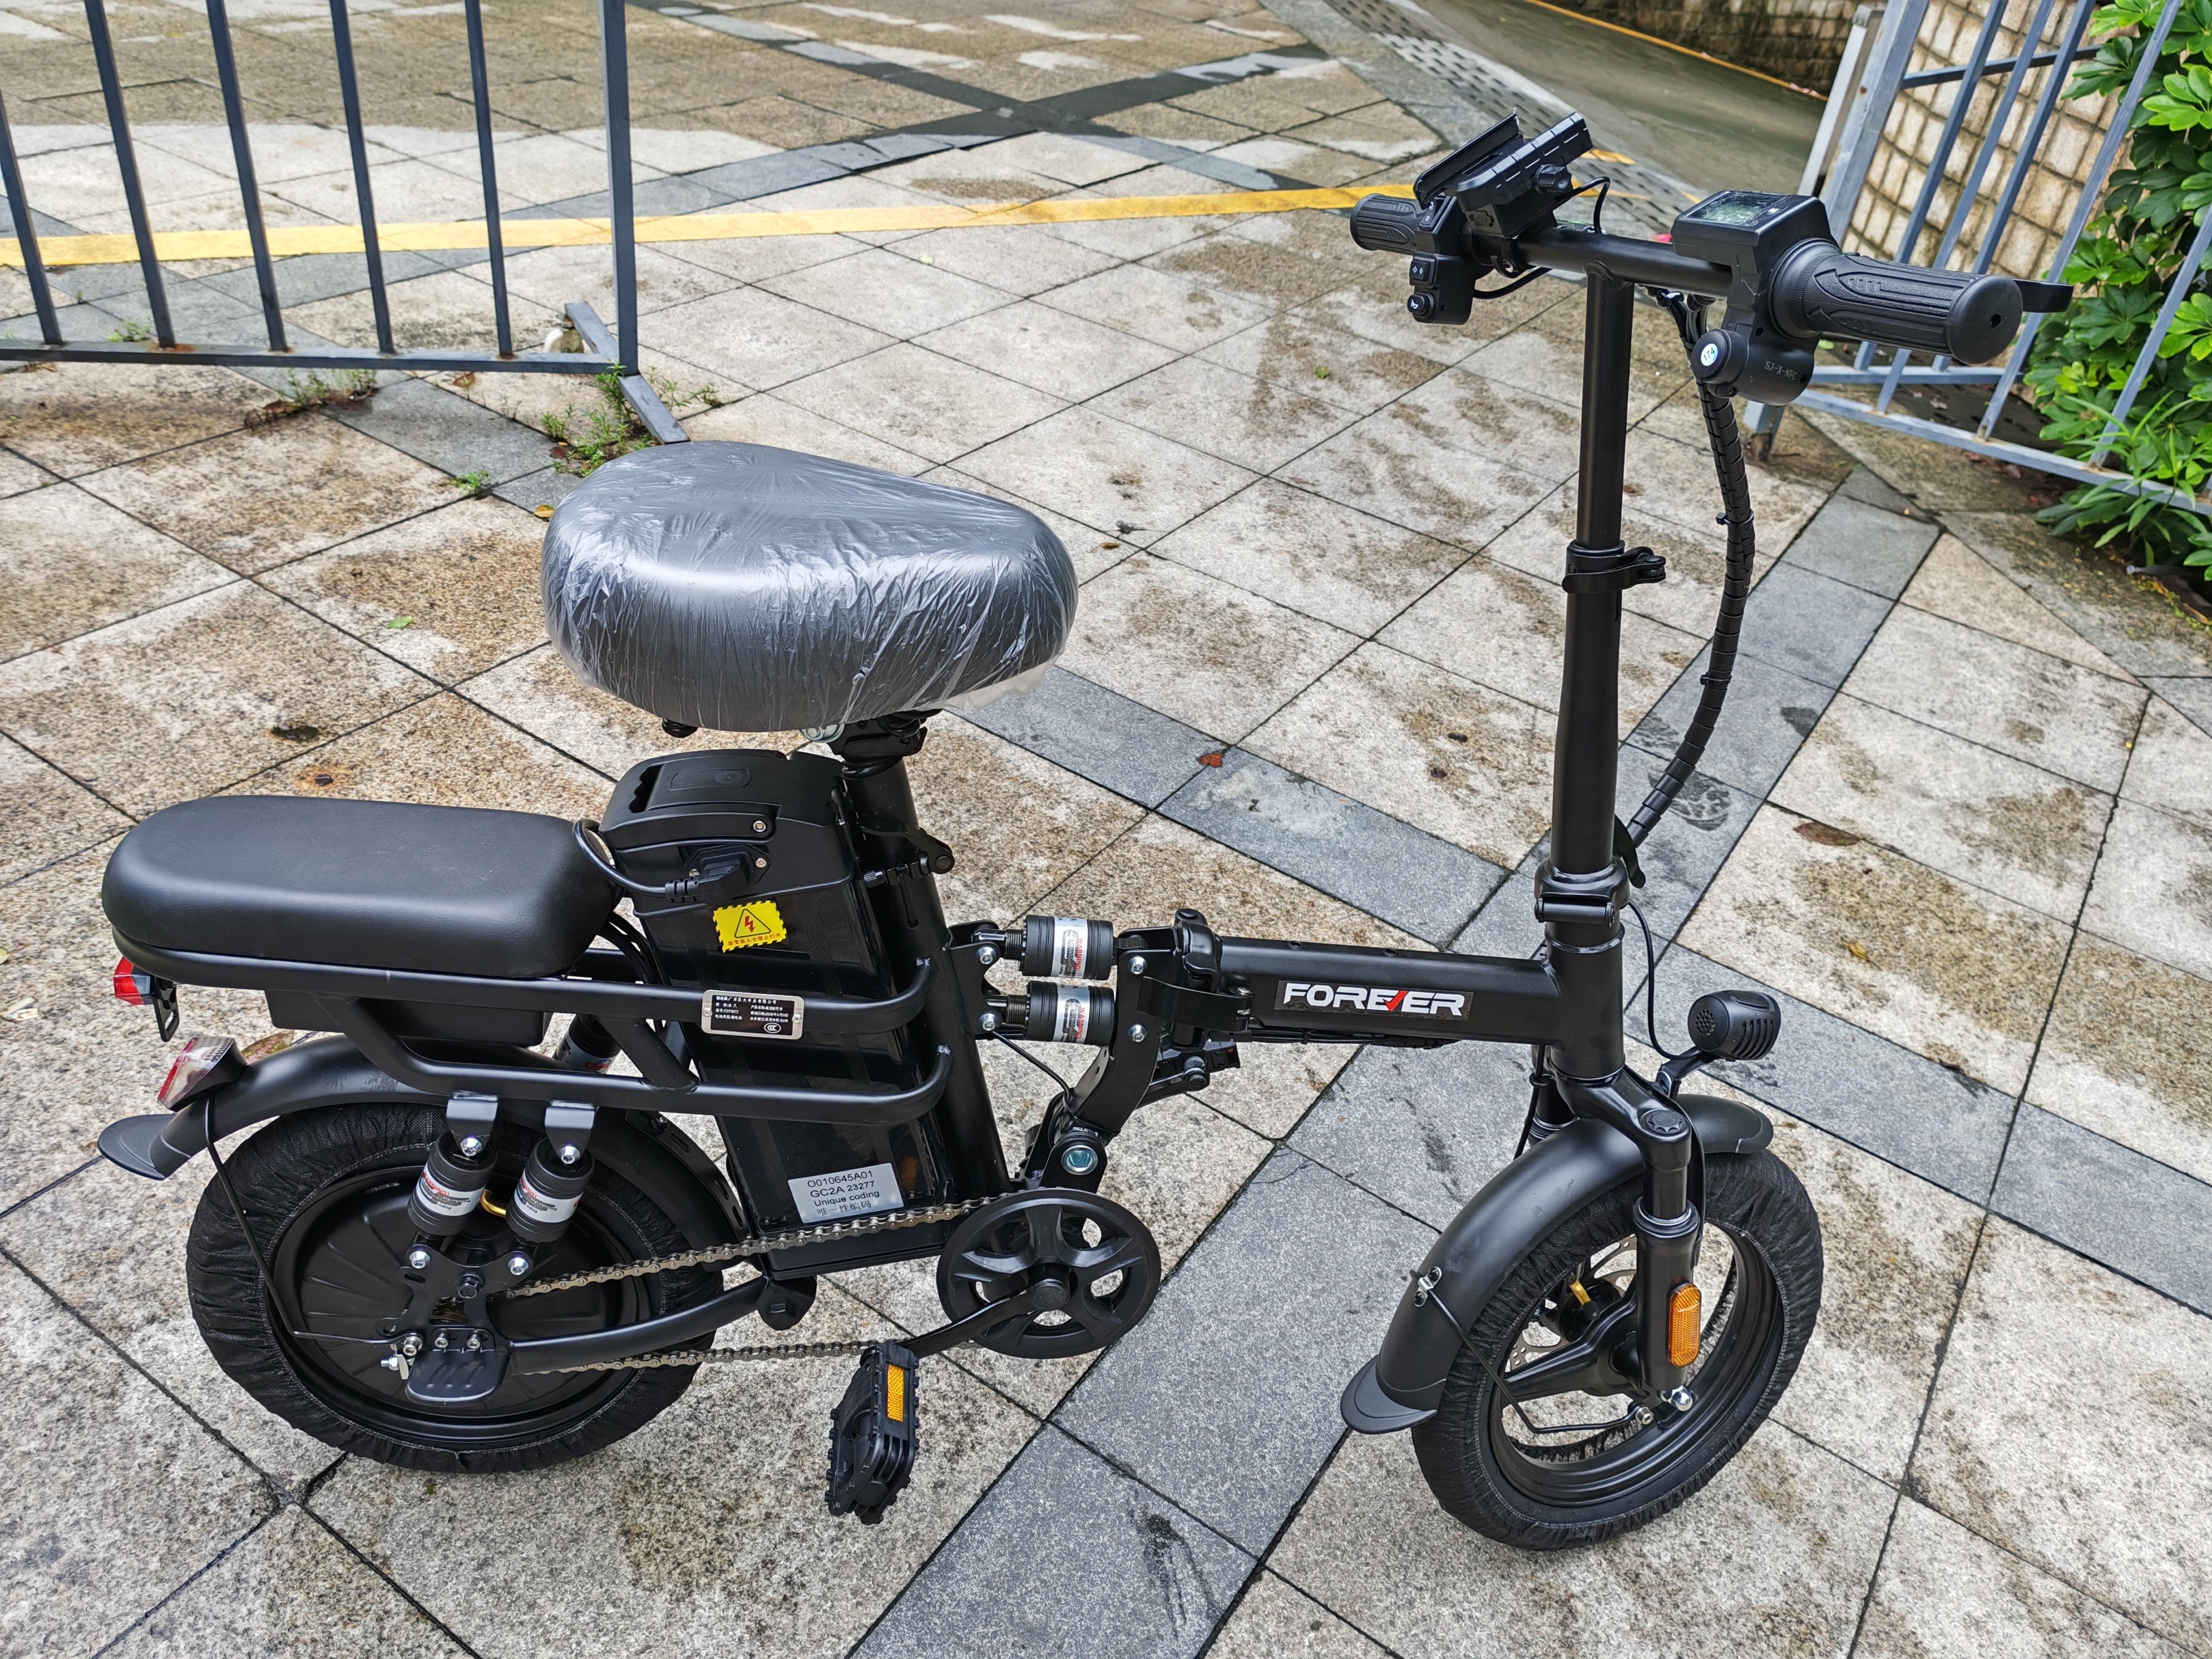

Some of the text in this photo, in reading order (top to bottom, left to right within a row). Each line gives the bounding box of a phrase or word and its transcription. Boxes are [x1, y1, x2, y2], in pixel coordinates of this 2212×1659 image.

[1703, 347, 1715, 361] 174
[1764, 361, 1798, 380] SJ-X-NFC
[1283, 982, 1465, 1016] FOREVER
[810, 1181, 875, 1198] GC2A 23277
[814, 1191, 880, 1207] Unique coding
[817, 1200, 872, 1216] 唯一性编码
